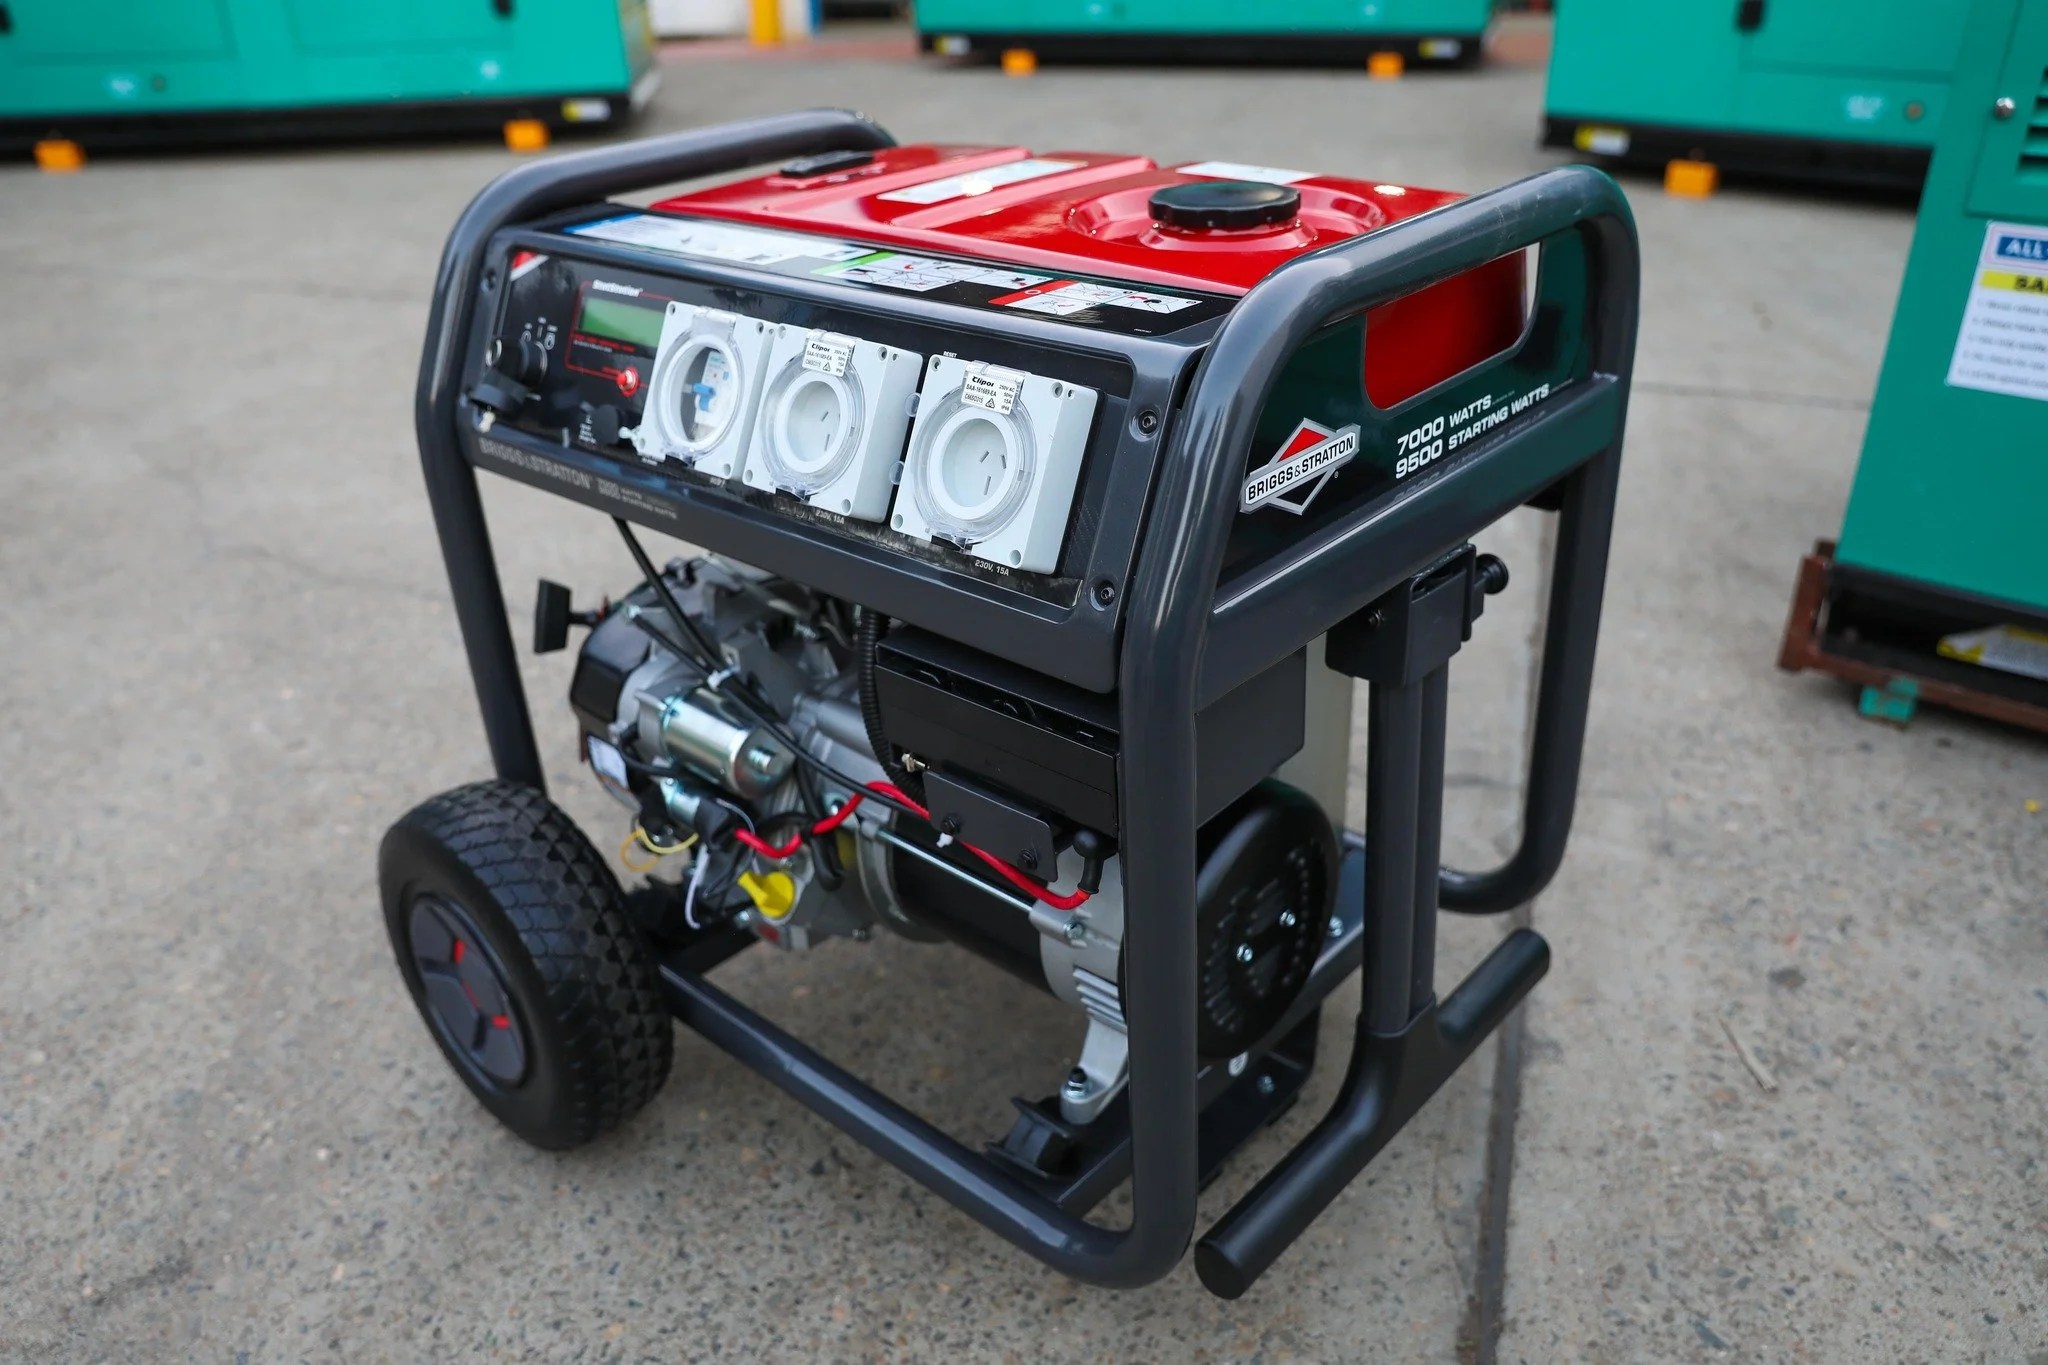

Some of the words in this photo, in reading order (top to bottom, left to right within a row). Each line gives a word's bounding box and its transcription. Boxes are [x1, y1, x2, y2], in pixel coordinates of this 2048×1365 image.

[2014, 275, 2048, 293] SA
[1395, 438, 1443, 479] 9500
[1448, 405, 1509, 451] STARTING
[1511, 382, 1550, 415] WATTS
[1397, 415, 1444, 456] 7000
[1449, 394, 1492, 428] WATTS
[975, 559, 994, 572] 230V,
[996, 565, 1009, 576] 15A
